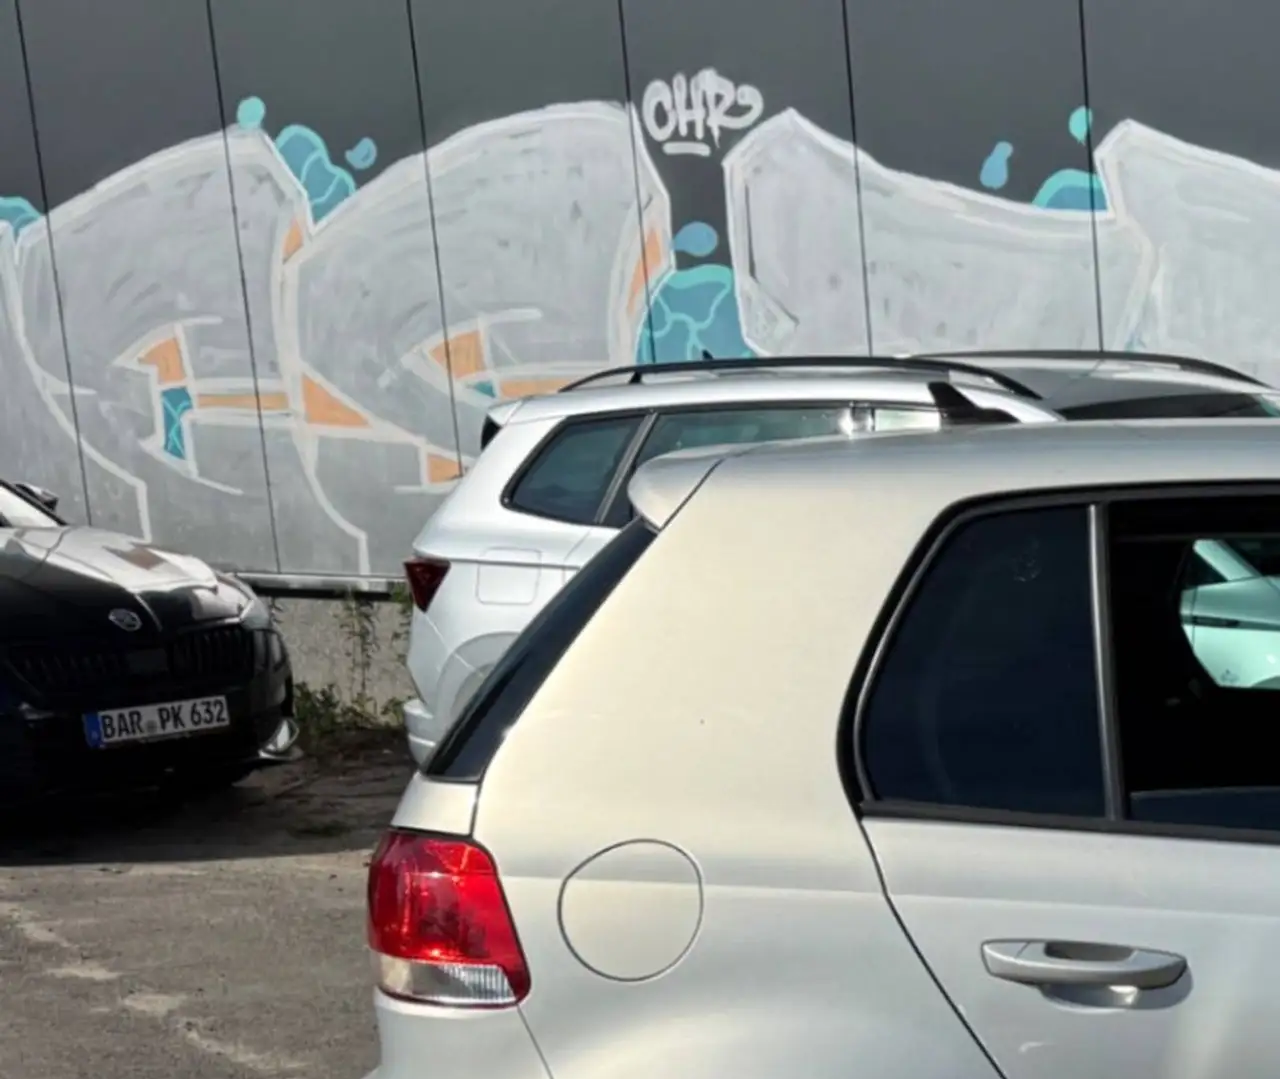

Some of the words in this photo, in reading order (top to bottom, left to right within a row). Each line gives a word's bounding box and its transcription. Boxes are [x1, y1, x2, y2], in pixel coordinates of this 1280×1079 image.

[101, 710, 144, 739] BAR
[157, 704, 185, 731] PK
[190, 699, 226, 726] 632
